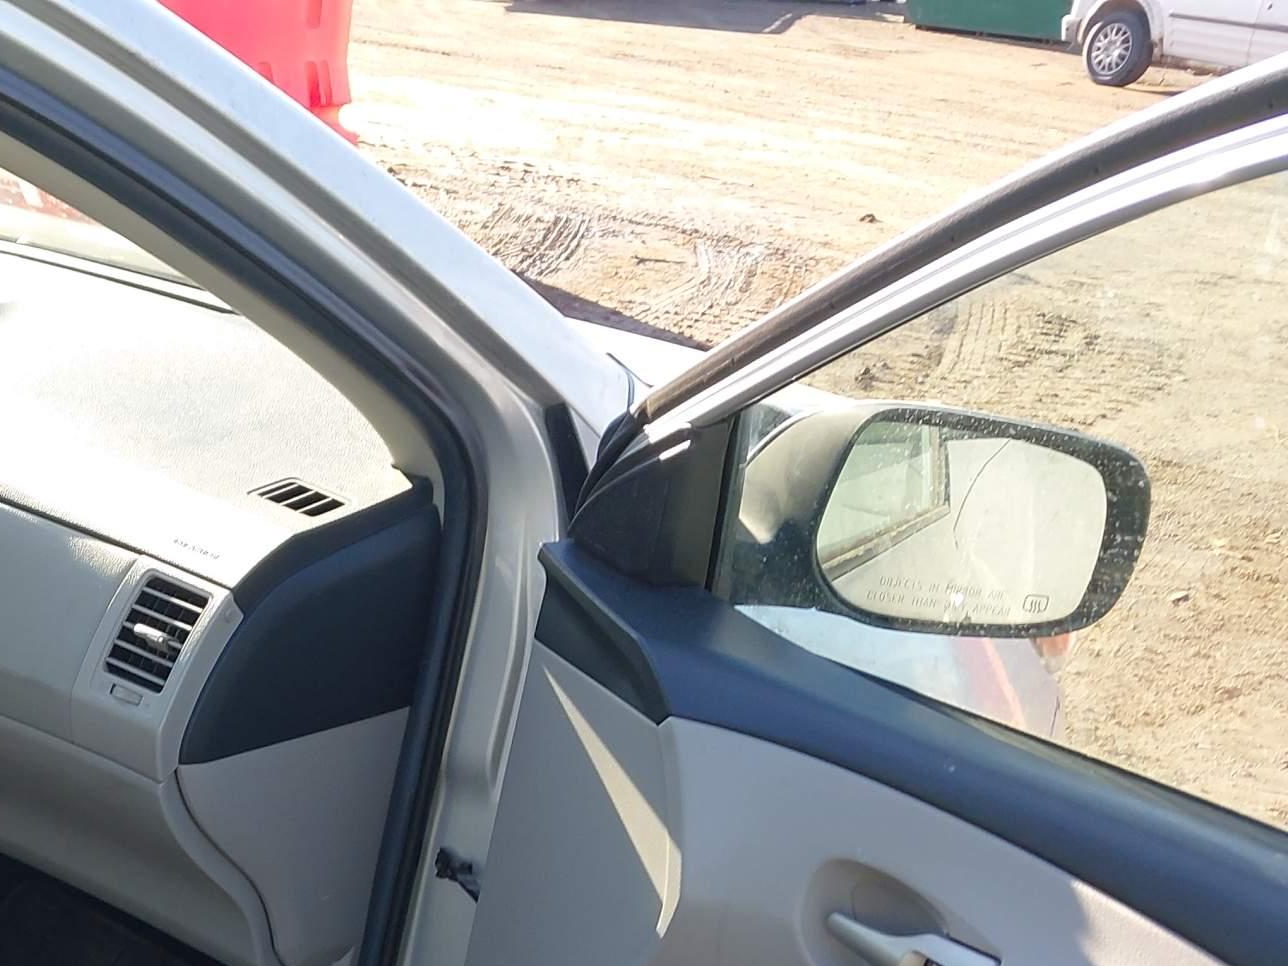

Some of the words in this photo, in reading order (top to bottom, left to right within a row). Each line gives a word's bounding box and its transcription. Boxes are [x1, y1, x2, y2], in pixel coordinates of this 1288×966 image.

[879, 575, 922, 589] OBJECTS
[928, 582, 940, 593] IN
[866, 590, 904, 603] CLOSER
[911, 597, 937, 609] THAN
